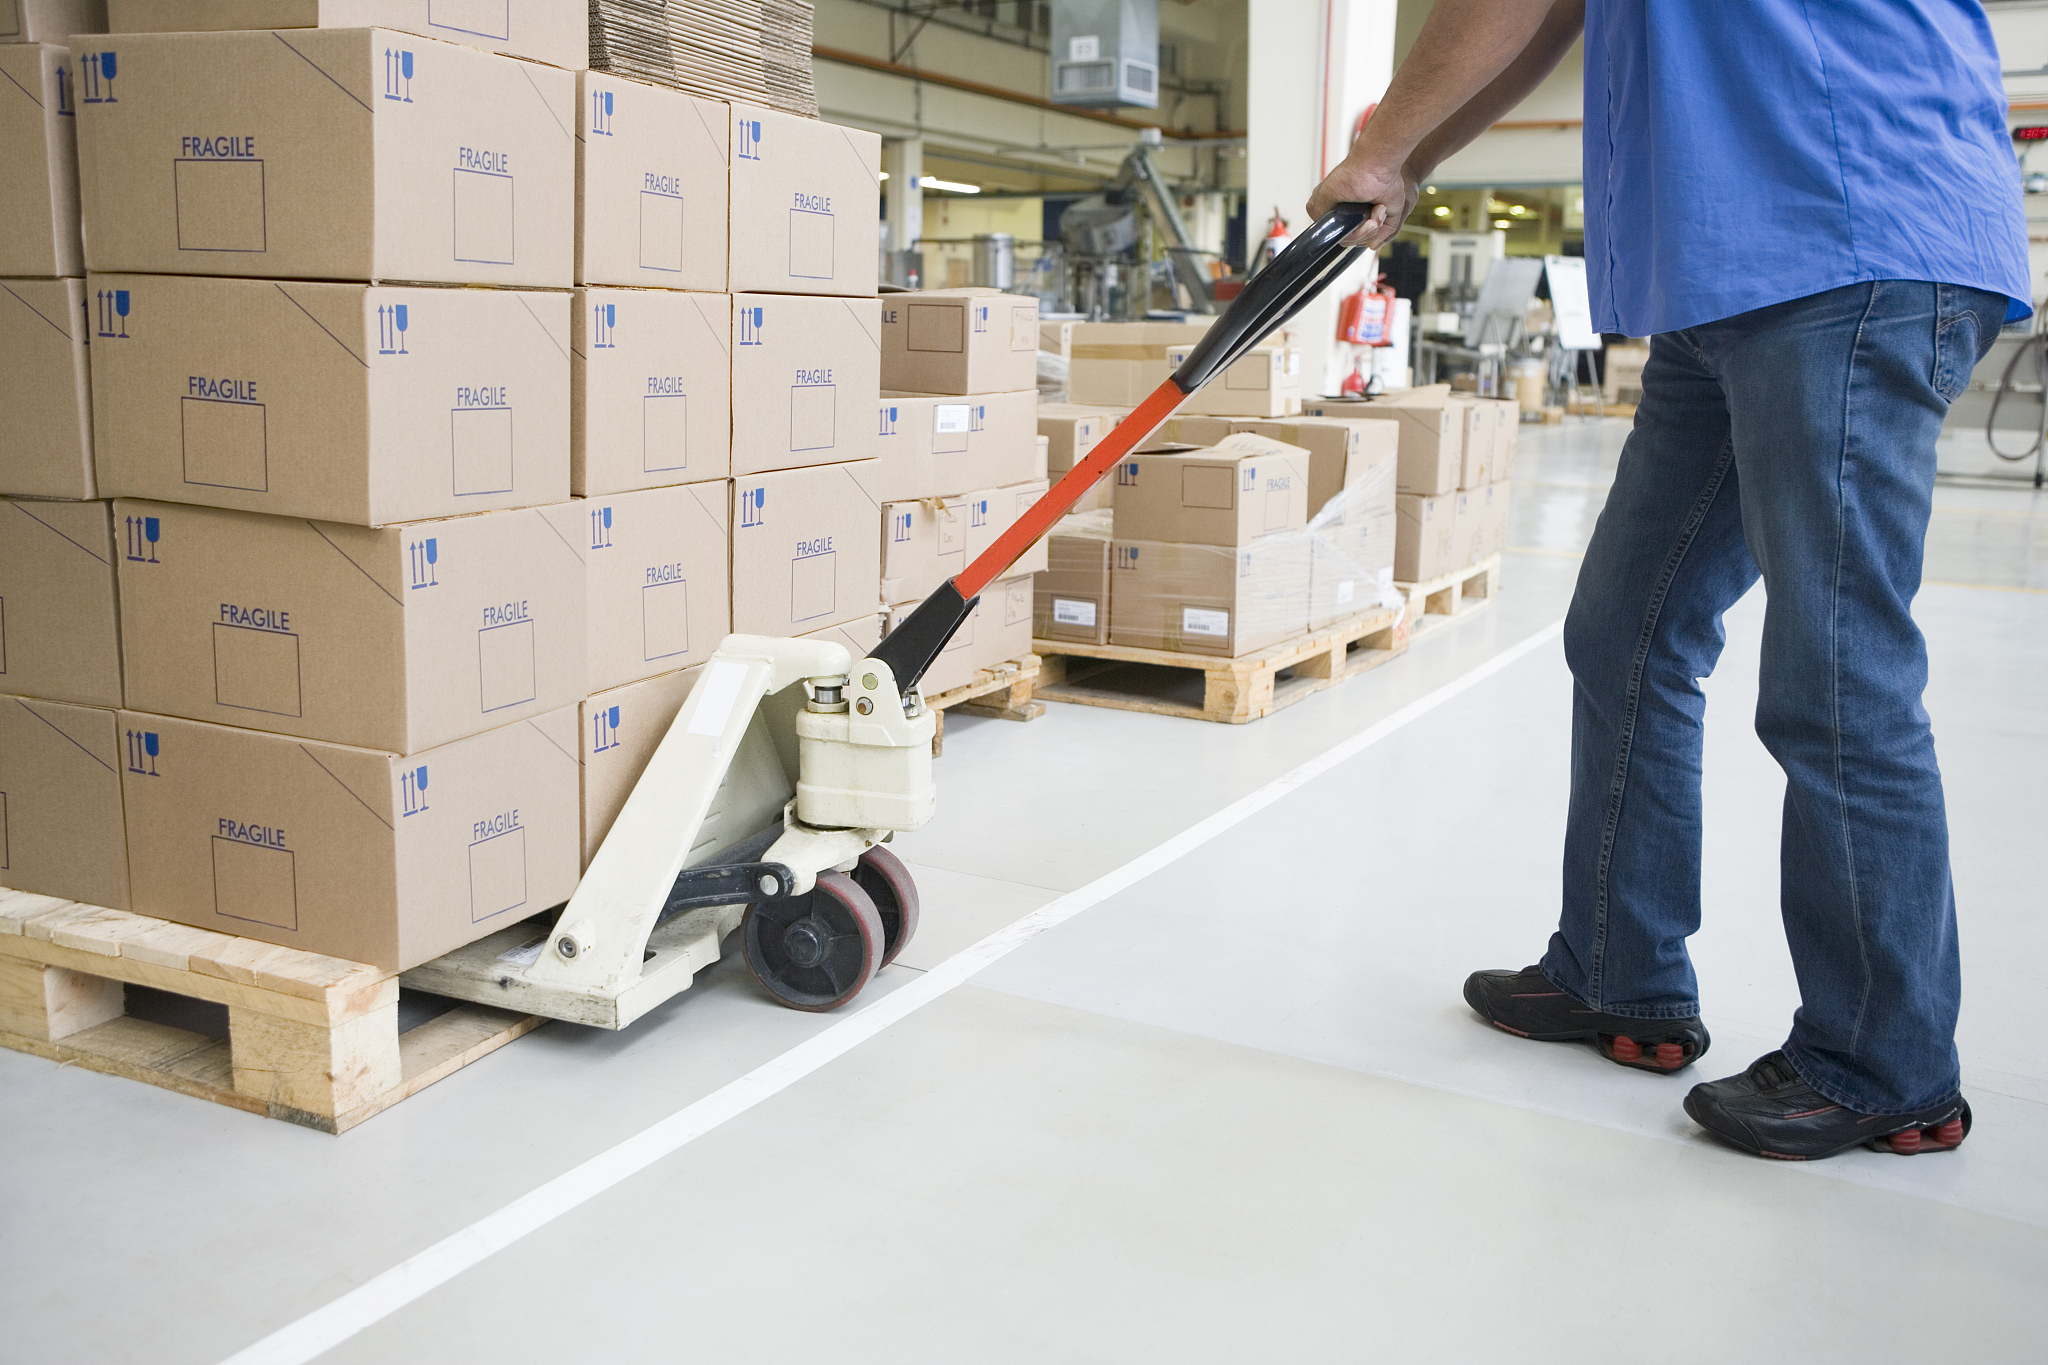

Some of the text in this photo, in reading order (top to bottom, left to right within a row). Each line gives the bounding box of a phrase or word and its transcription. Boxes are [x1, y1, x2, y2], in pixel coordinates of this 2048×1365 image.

[182, 136, 255, 158] FRAGILE
[459, 147, 508, 174] FRAGILE
[644, 173, 680, 195] FRAGILE
[794, 192, 831, 212] FRAGILE
[647, 376, 683, 394] FRAGILE
[795, 369, 833, 385] FRAGILE
[188, 376, 257, 402] FRAGILE
[457, 386, 507, 407] FRAGILE
[1266, 476, 1291, 491] FRAGILE
[796, 537, 833, 557] FRAGILE
[646, 563, 682, 584] FRAGILE
[220, 602, 290, 632] FRAGILE
[483, 600, 529, 627] FRAGILE
[218, 817, 286, 848] FRAGILE
[473, 809, 519, 841] FRAGILE
